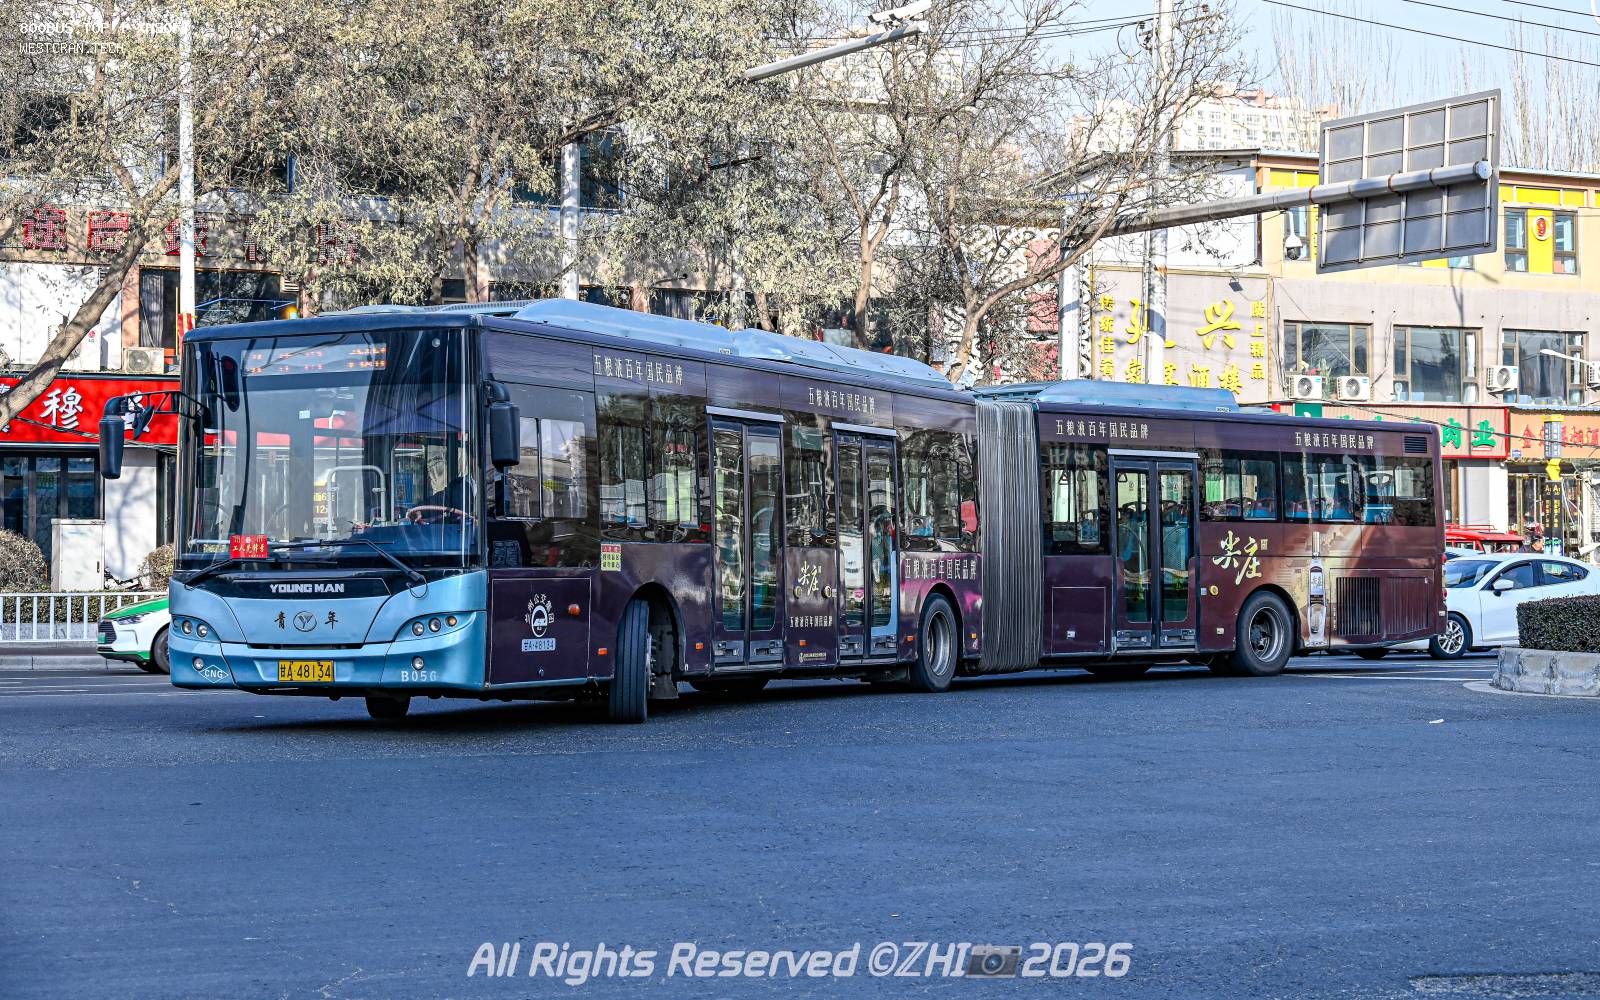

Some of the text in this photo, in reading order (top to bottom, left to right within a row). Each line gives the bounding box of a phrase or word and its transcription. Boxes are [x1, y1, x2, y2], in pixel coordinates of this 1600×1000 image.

[593, 354, 684, 386] 五粮液百年国民品牌
[808, 386, 876, 416] 五粮液百年国民品牌
[1056, 419, 1149, 440] 五粮液百年国民品牌
[1295, 431, 1374, 450] 五粮液百年国民品牌
[904, 558, 977, 581] 五粮液百年国民品牌
[269, 583, 345, 594] YOUNG MAN
[204, 669, 224, 679] CNG
